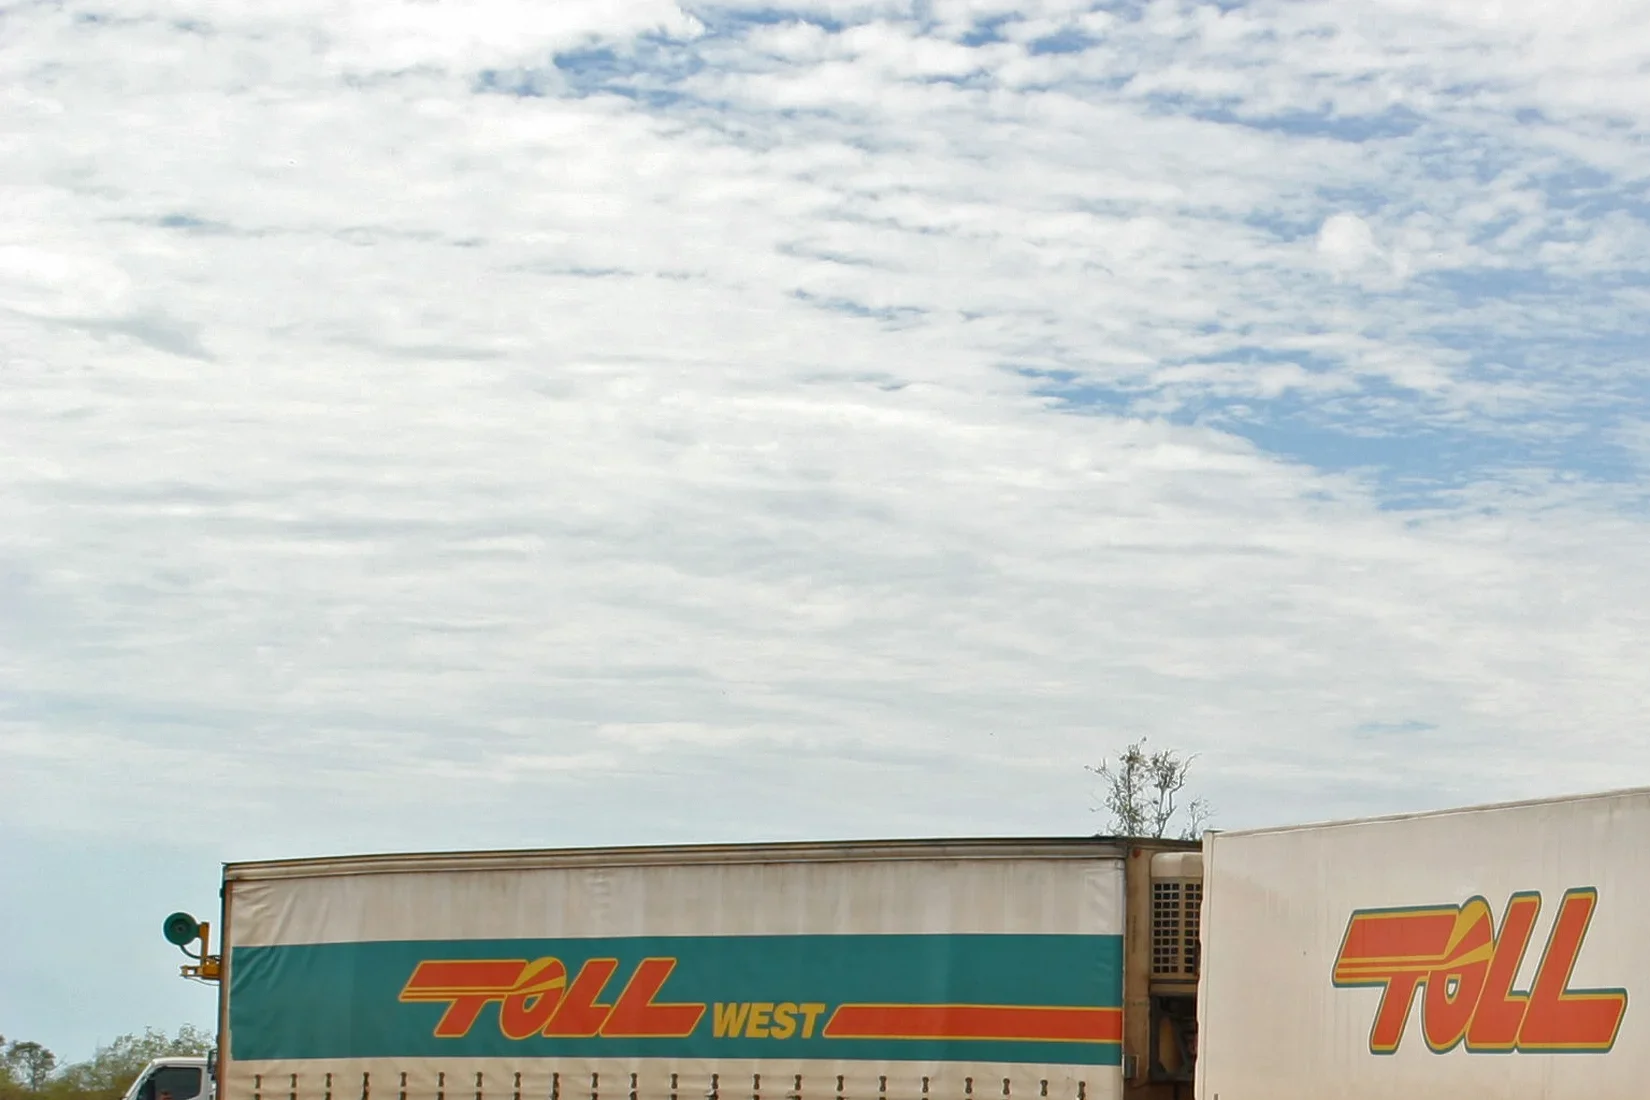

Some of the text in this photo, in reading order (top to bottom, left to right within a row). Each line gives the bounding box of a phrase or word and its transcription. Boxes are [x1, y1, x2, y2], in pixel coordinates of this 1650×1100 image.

[399, 956, 826, 1040] TOLL WEST
[1331, 886, 1628, 1055] TOLL
